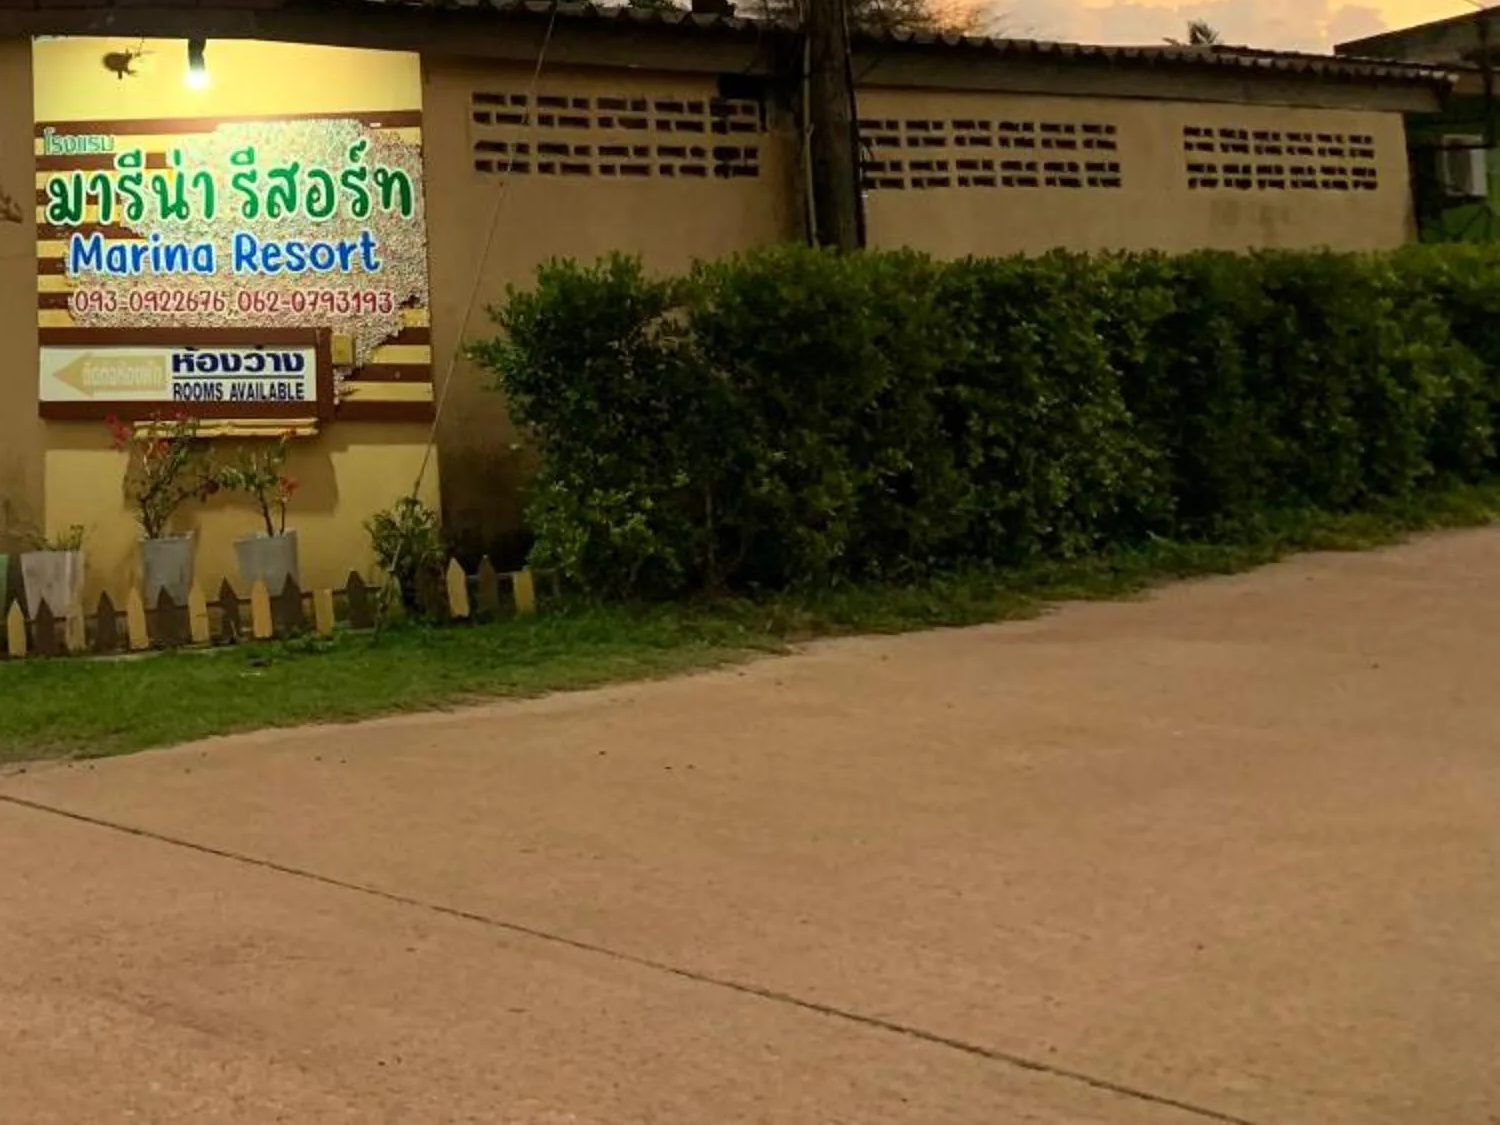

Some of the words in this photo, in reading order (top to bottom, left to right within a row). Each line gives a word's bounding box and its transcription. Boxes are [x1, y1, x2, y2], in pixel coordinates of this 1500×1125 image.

[47, 149, 215, 223] มารีน่า
[231, 140, 413, 220] รีสอร์ท
[71, 234, 215, 274] Marina
[234, 231, 381, 272] Resort
[237, 290, 394, 313] 062-0793193
[172, 345, 305, 373] ห้องว่าง
[173, 382, 223, 400] ROOMS
[230, 382, 305, 400] AVAILABLE
